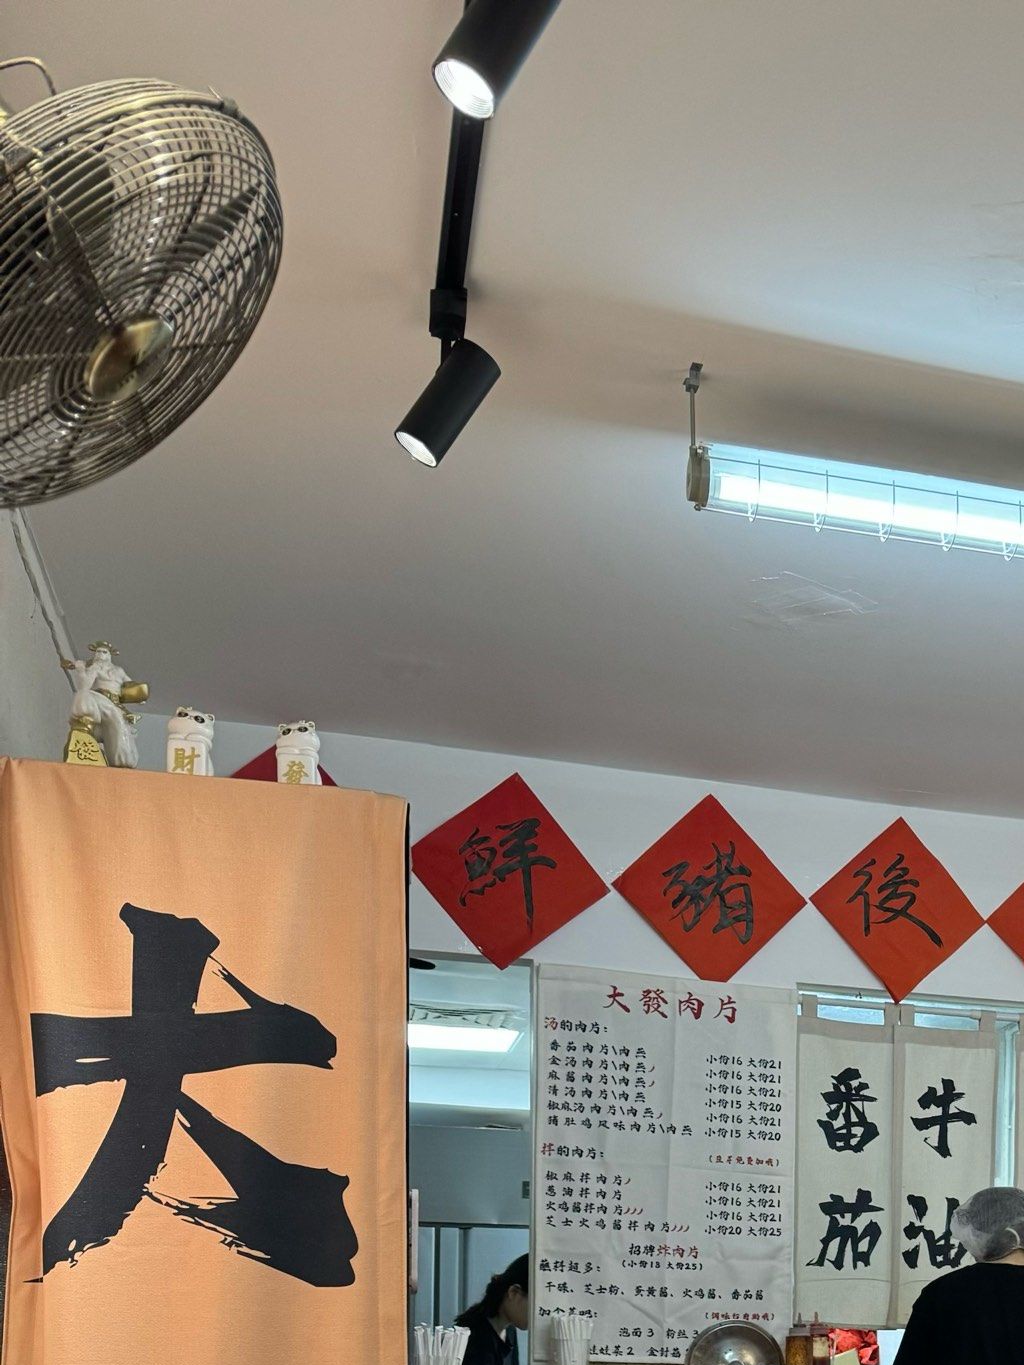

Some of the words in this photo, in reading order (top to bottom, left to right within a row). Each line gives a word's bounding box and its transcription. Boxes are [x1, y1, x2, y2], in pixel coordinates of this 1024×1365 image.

[602, 984, 738, 1024] 大發肉片
[706, 1054, 742, 1066] 小份16
[747, 1057, 782, 1070] 大份21
[706, 1069, 742, 1081] 小份16
[747, 1072, 782, 1085] 大份21
[705, 1083, 742, 1095] 小份16
[747, 1086, 781, 1098] 大份21
[705, 1098, 741, 1110] 小份15
[747, 1101, 782, 1113] 大份20
[706, 1113, 743, 1124] 小份16
[748, 1115, 781, 1127] 大份21
[704, 1128, 741, 1139] 小份15
[747, 1130, 781, 1142] 大份20
[806, 1066, 884, 1269] 番茄
[705, 1181, 742, 1193] 小份16
[747, 1184, 781, 1195] 大份21
[705, 1196, 742, 1207] 小份16
[747, 1198, 781, 1209] 大份21
[706, 1210, 742, 1221] 小份16
[747, 1213, 782, 1223] 大份21
[704, 1225, 742, 1236] 小份20
[747, 1227, 782, 1238] 大份25
[628, 1243, 700, 1260] 招牌炸肉片
